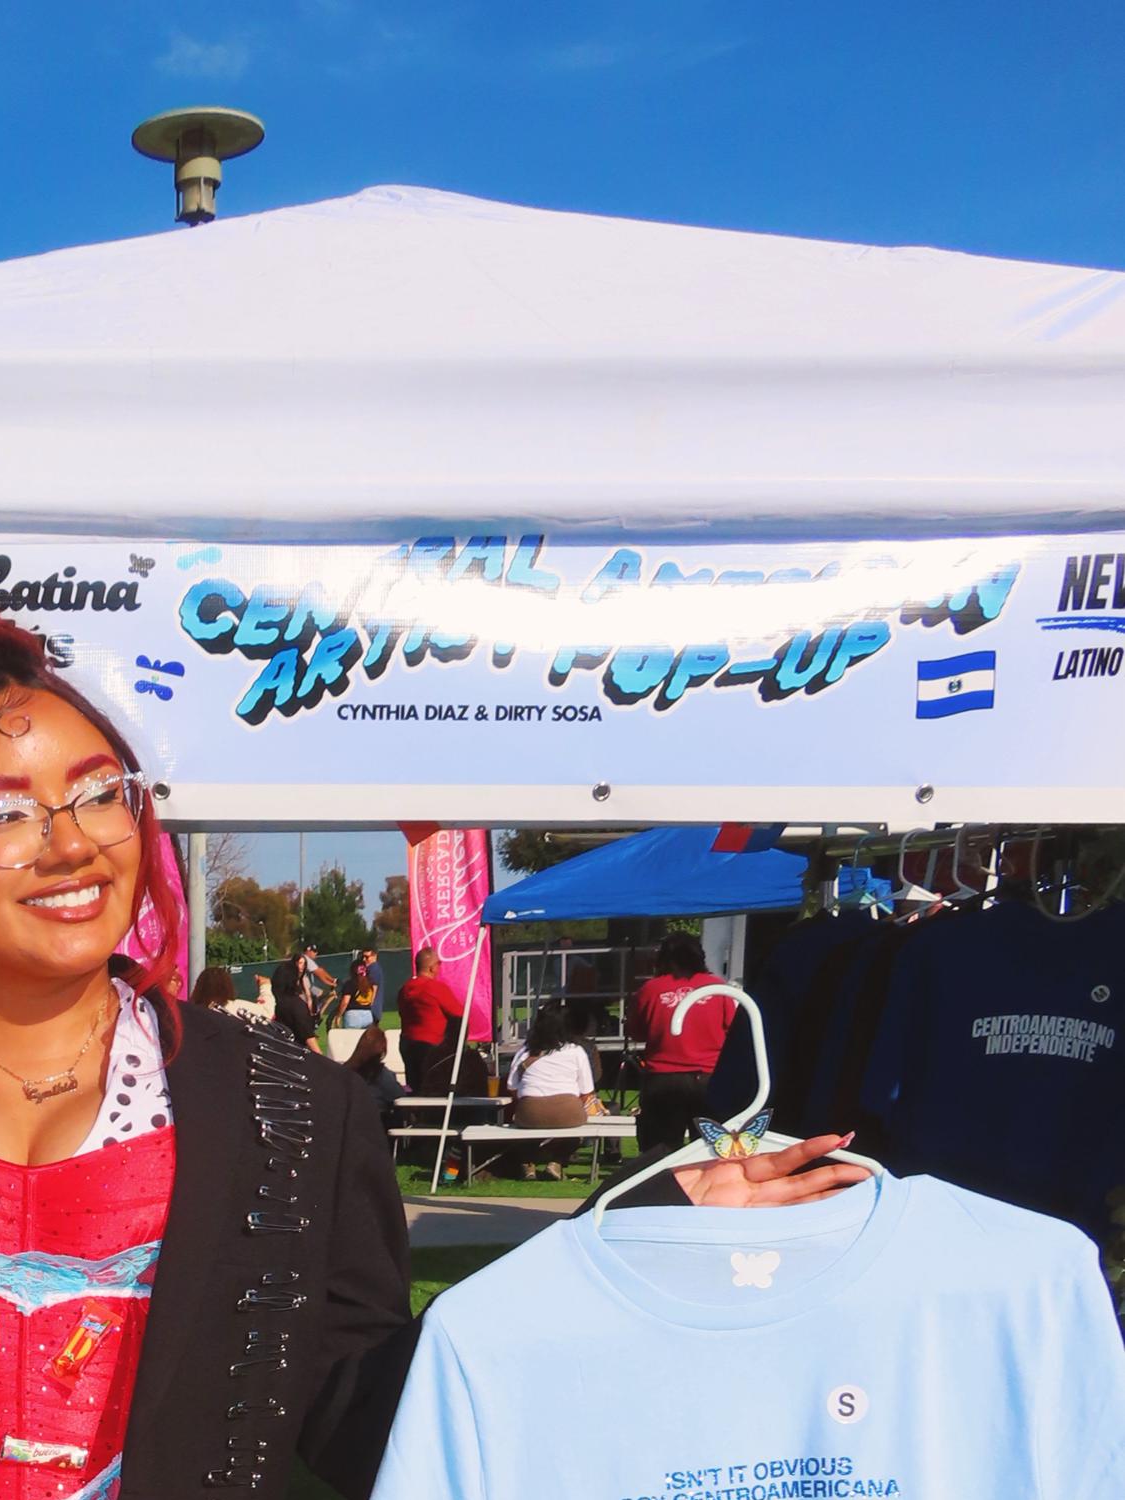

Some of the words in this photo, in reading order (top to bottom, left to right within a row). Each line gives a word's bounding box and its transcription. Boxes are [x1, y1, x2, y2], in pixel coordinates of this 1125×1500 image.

[178, 534, 562, 660] CENRAL
[1052, 646, 1125, 681] LATINO
[336, 703, 419, 722] CYNTHIA
[425, 704, 469, 722] DIAZ
[475, 705, 489, 722] &
[495, 705, 547, 722] DIRTY
[551, 704, 603, 723] SOSA
[972, 1014, 1115, 1049] CENTROAMERICANO
[985, 1035, 1097, 1063] INDEPENDIENTE
[837, 1391, 856, 1417] S
[729, 1464, 748, 1484] IT
[753, 1456, 853, 1481] OBVIOUS
